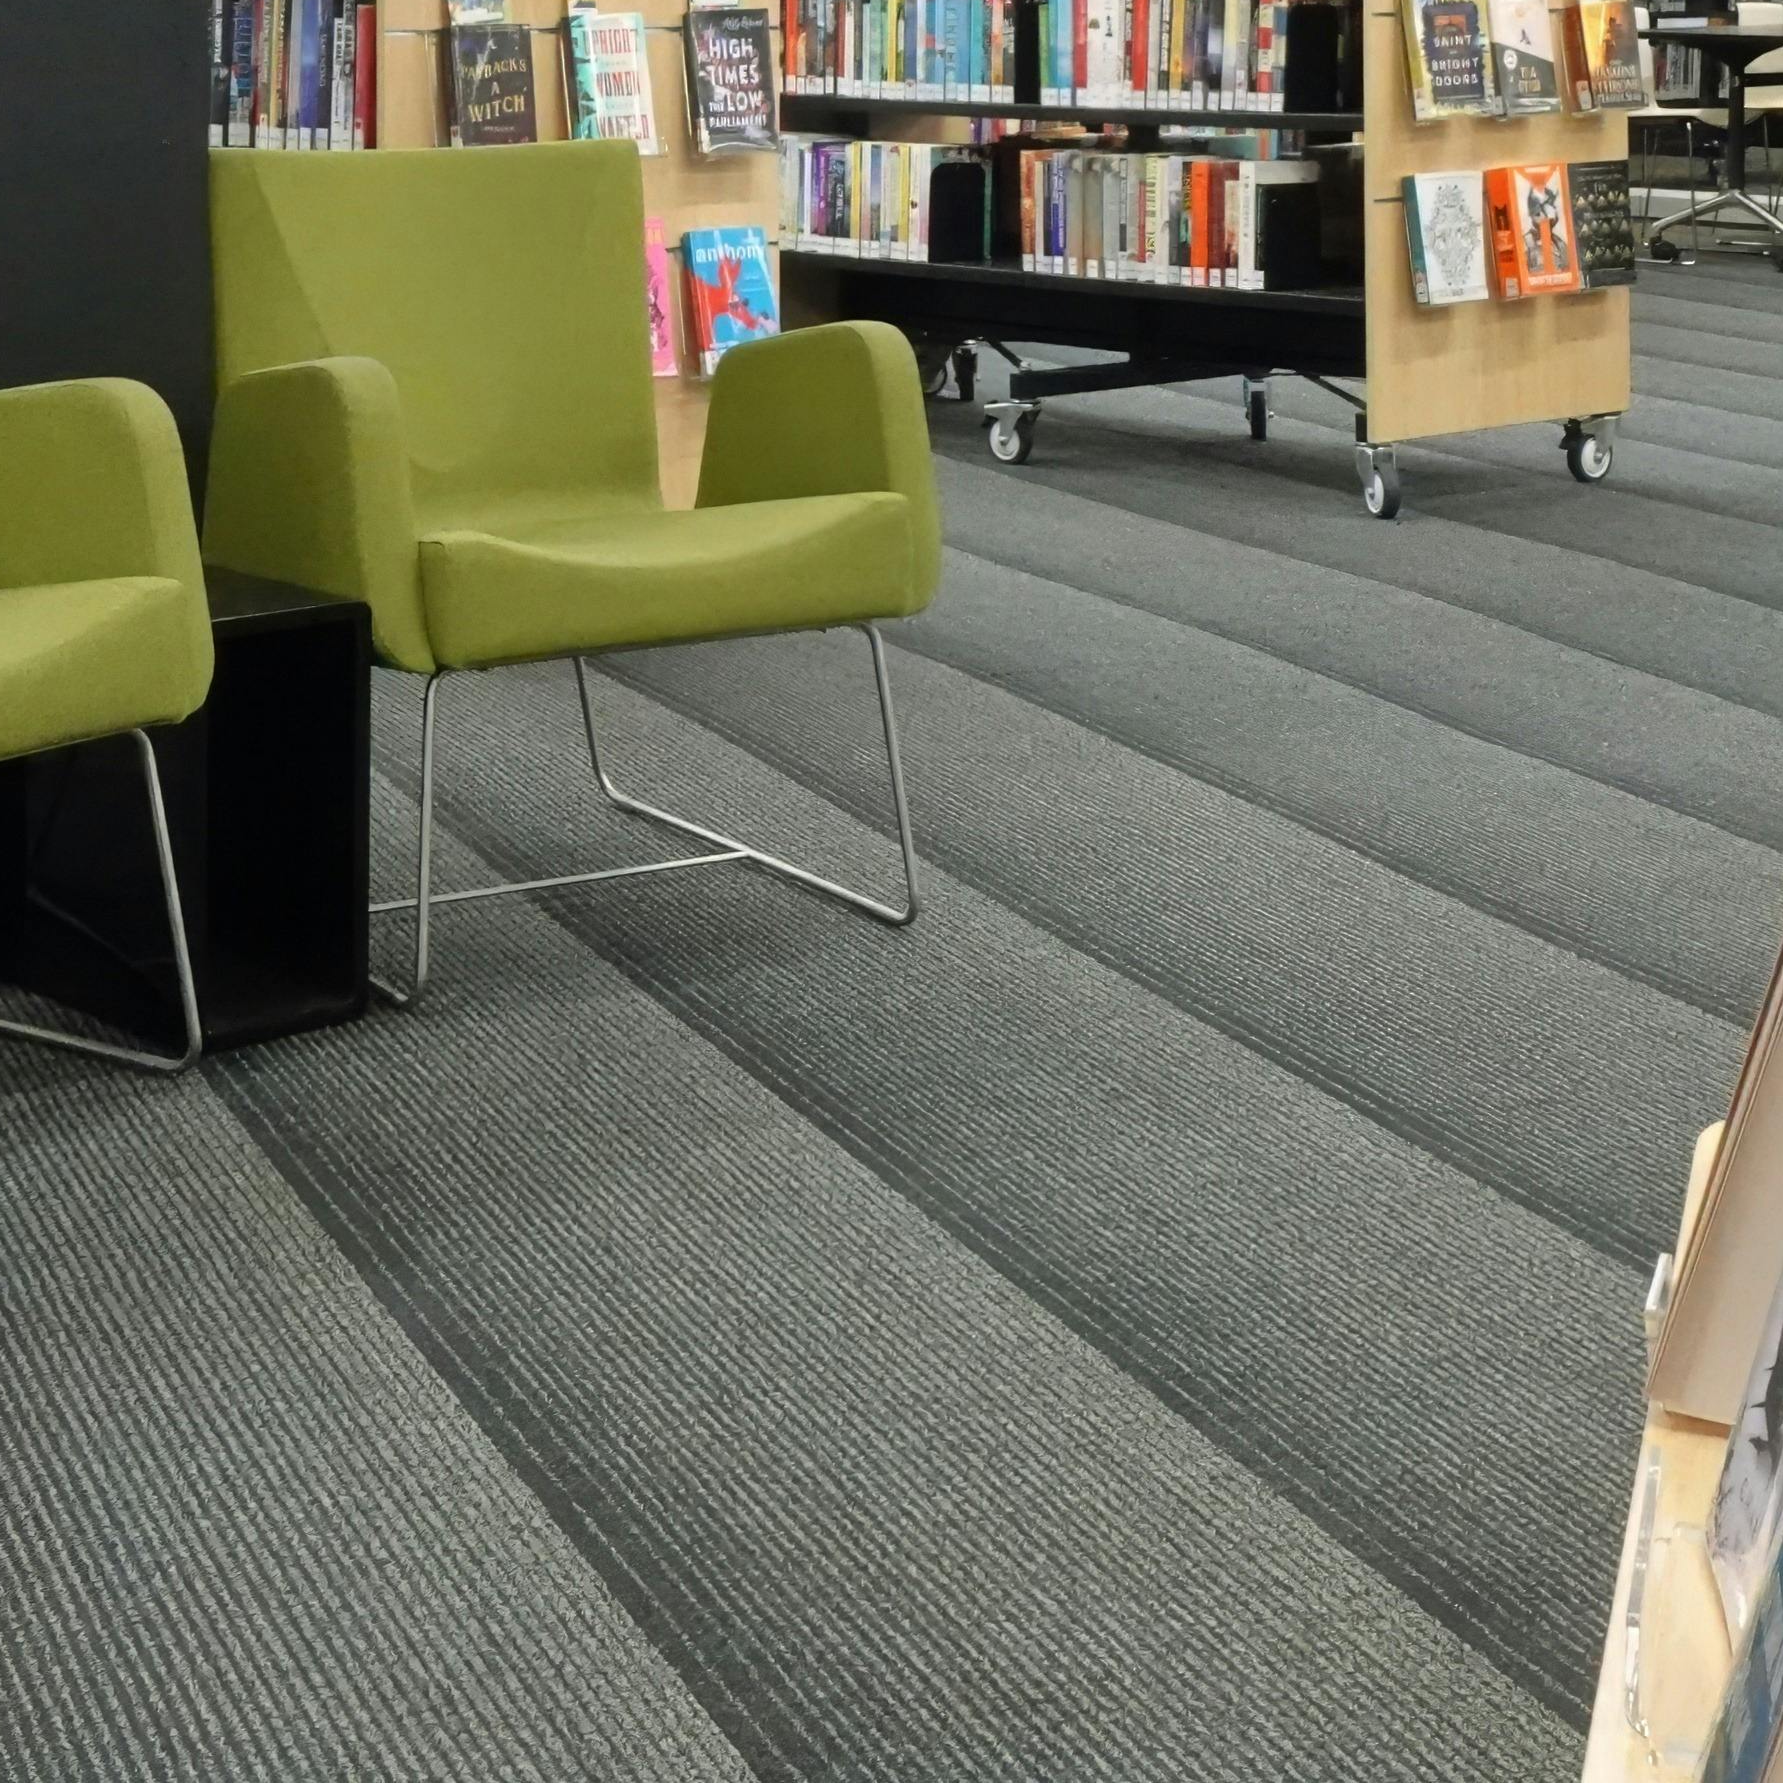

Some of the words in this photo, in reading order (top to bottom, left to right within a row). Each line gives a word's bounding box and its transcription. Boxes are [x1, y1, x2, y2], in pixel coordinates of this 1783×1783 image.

[709, 37, 754, 59] HIGH
[706, 64, 759, 86] TIMES
[468, 94, 525, 123] WITCH
[726, 90, 764, 112] LOW
